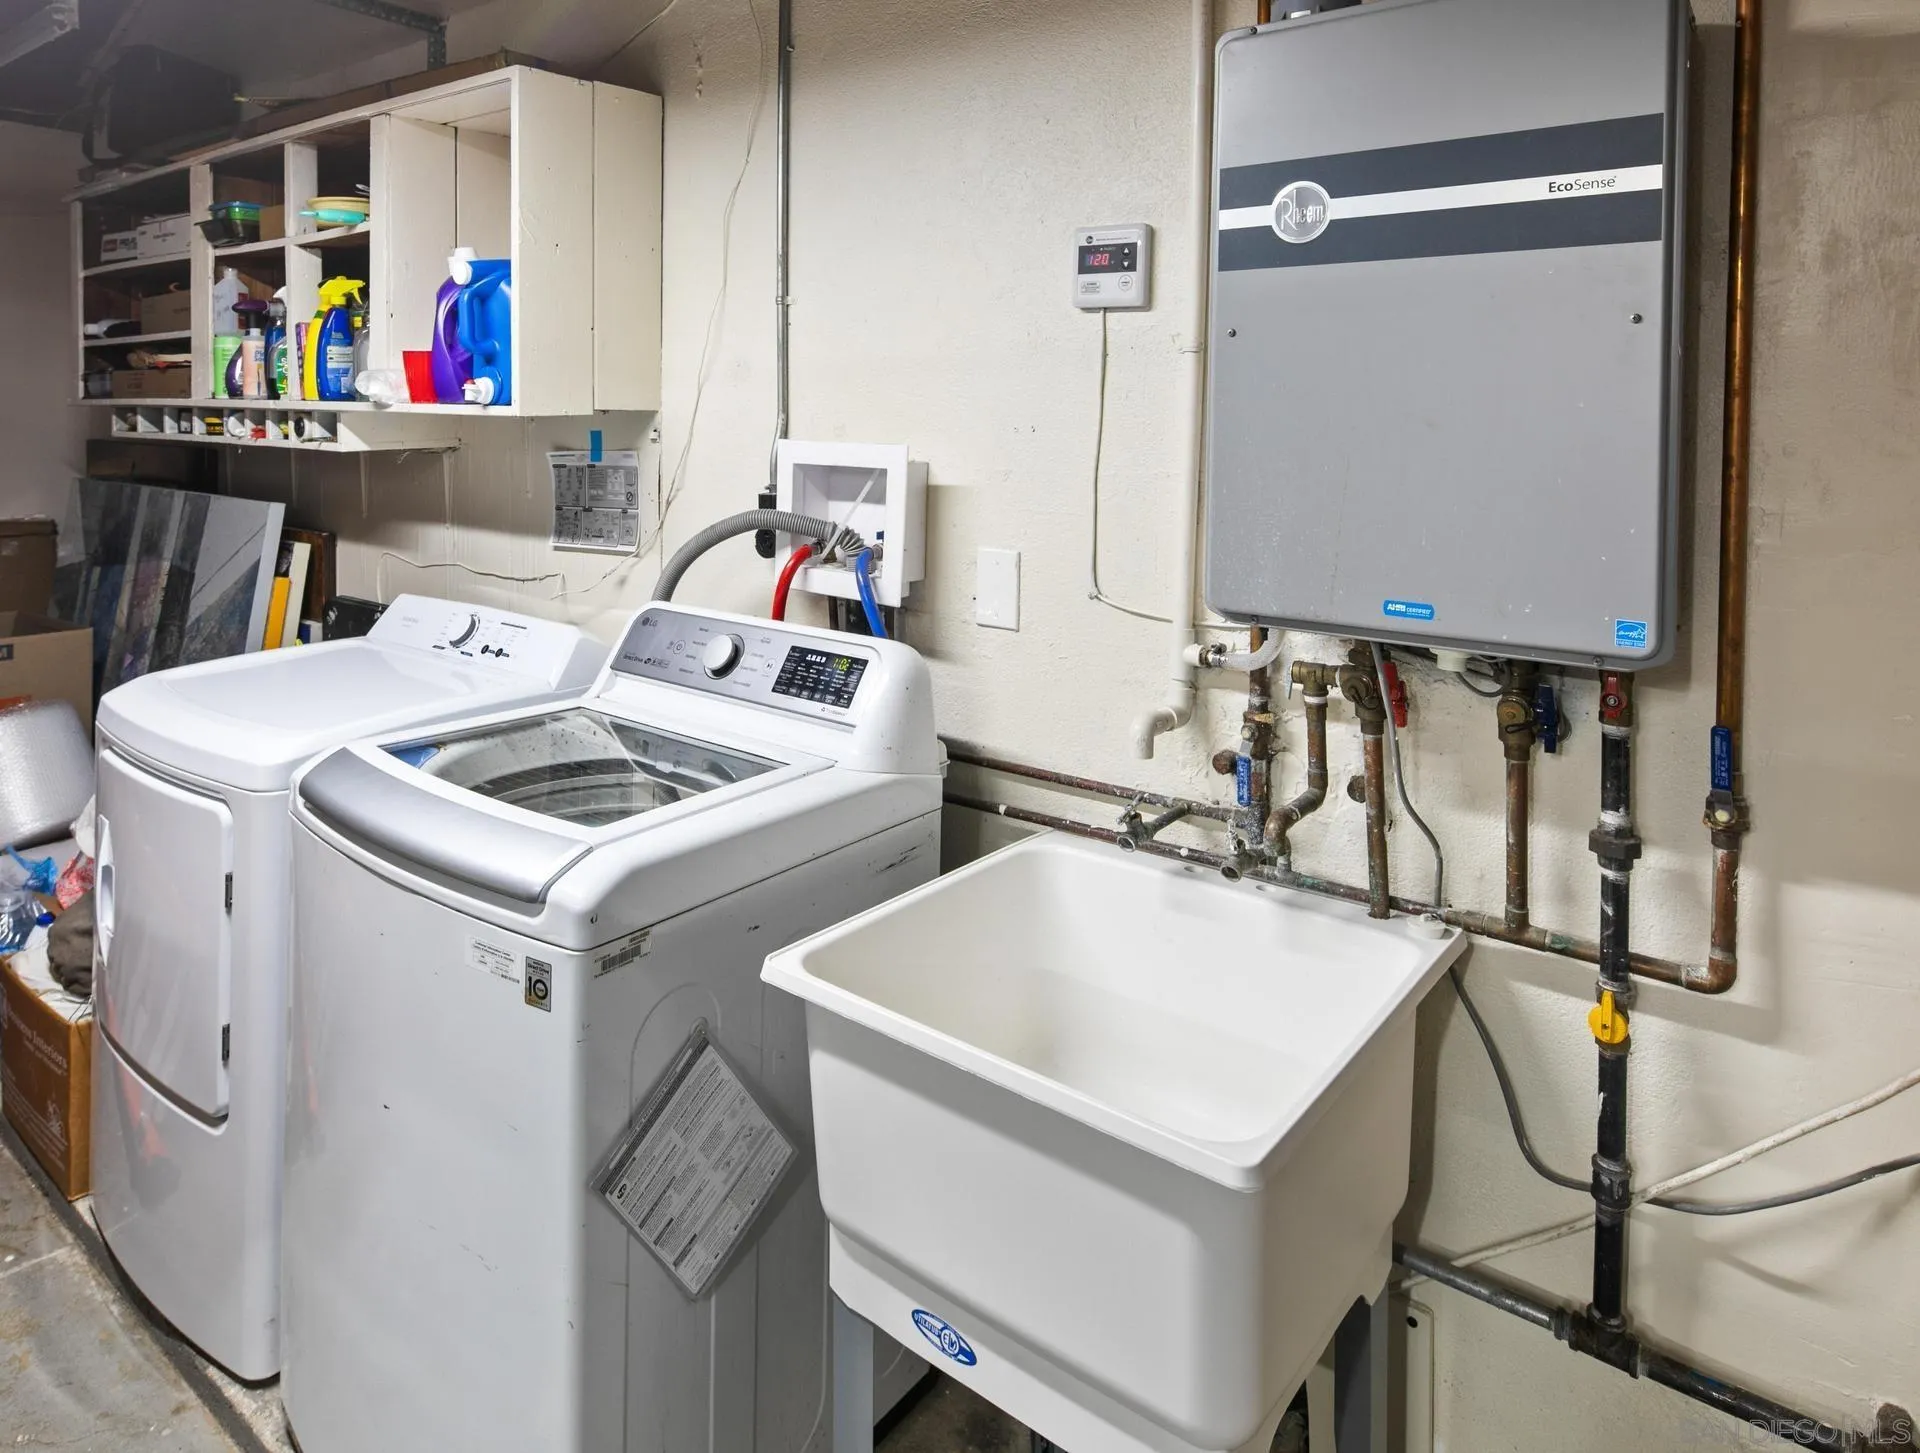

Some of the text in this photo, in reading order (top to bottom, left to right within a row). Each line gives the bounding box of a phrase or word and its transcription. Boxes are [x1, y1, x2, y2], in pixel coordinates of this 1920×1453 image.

[1548, 177, 1616, 193] EcoSense
[1280, 189, 1325, 230] Rheem
[1089, 253, 1110, 266] 120
